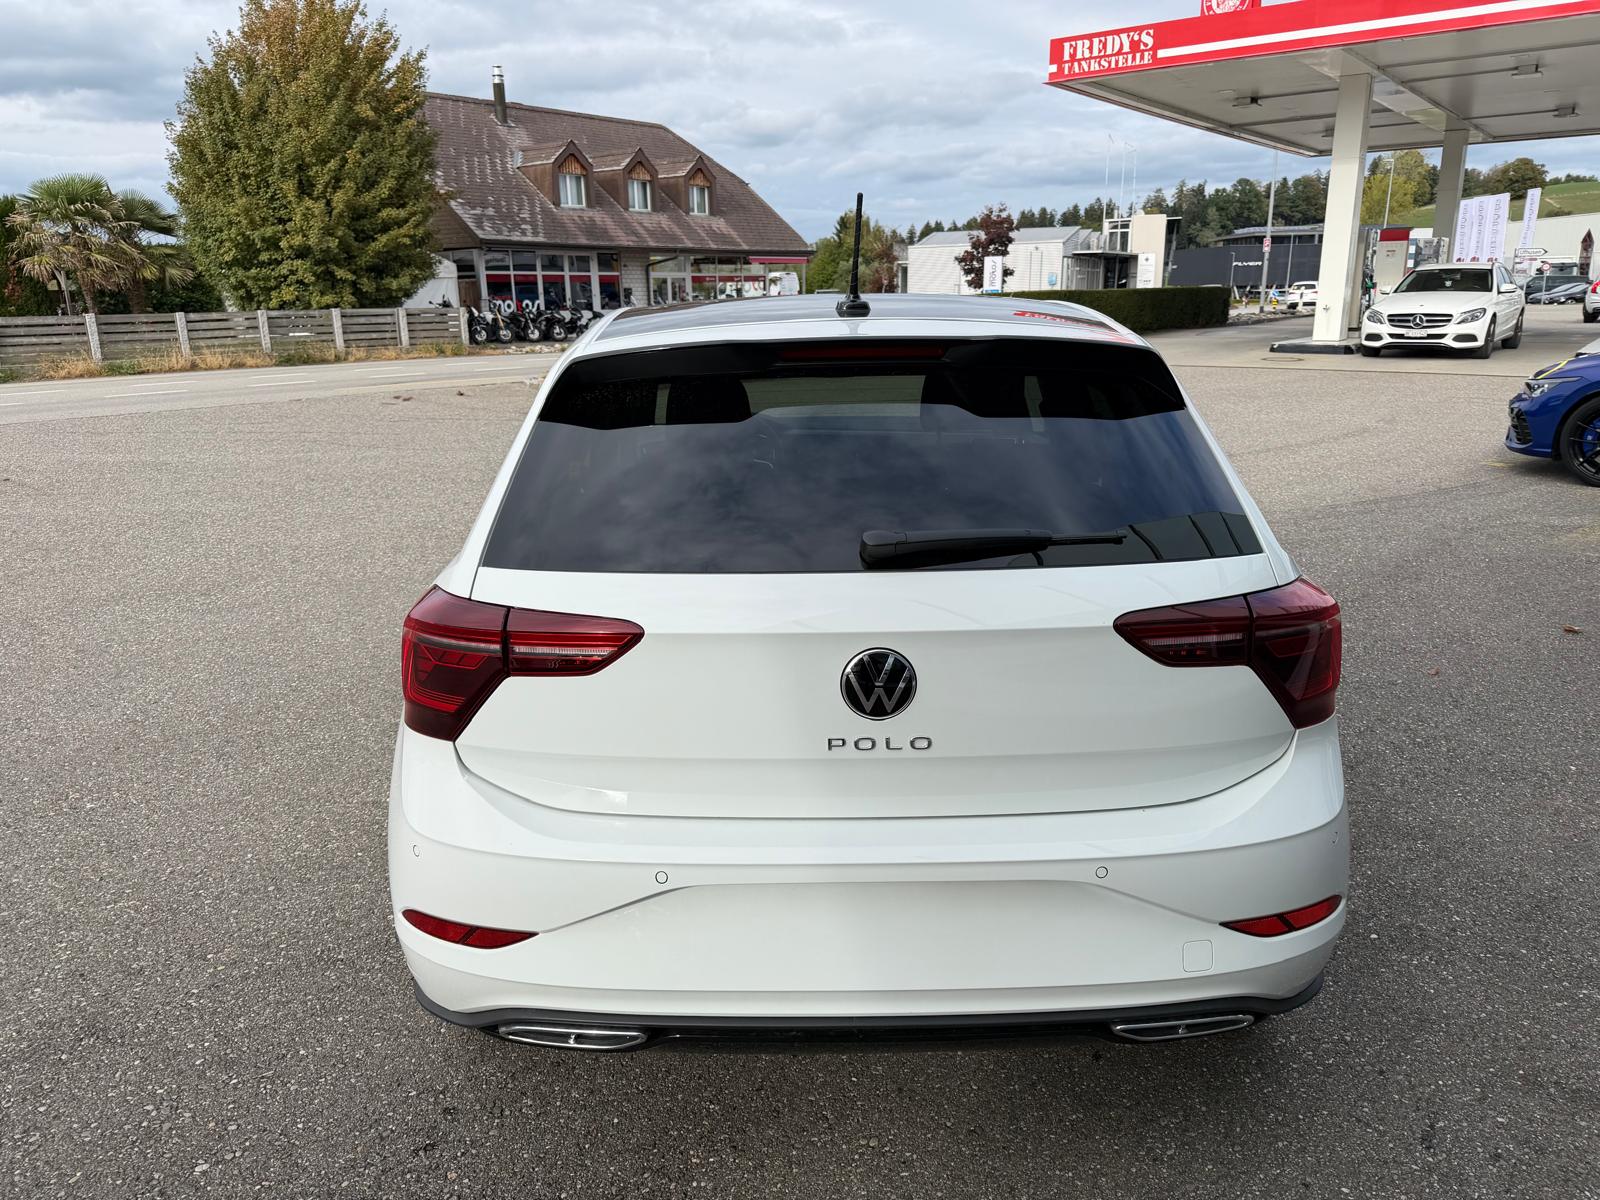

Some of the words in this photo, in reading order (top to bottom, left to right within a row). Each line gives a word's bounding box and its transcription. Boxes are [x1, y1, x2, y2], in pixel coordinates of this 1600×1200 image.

[1062, 28, 1155, 62] FREDY'S
[1062, 51, 1153, 75] TANKSTELLE
[827, 736, 933, 751] POLO
